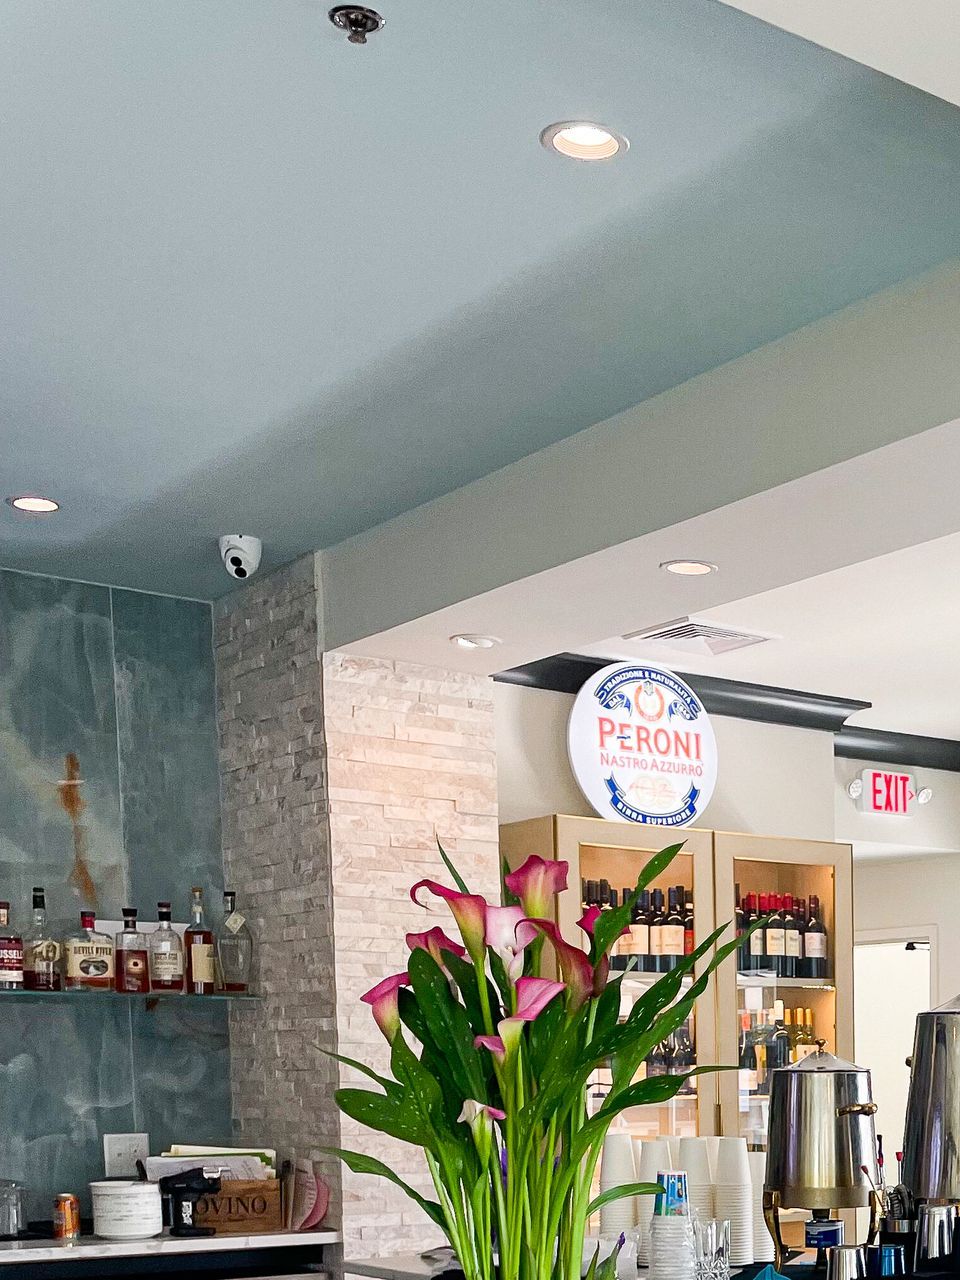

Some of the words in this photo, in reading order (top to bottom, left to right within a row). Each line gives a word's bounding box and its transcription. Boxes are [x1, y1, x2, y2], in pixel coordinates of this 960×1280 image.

[597, 716, 702, 760] PERONI
[600, 752, 648, 770] NASTRO
[650, 758, 703, 776] AZZURRO
[872, 772, 909, 813] EXIT
